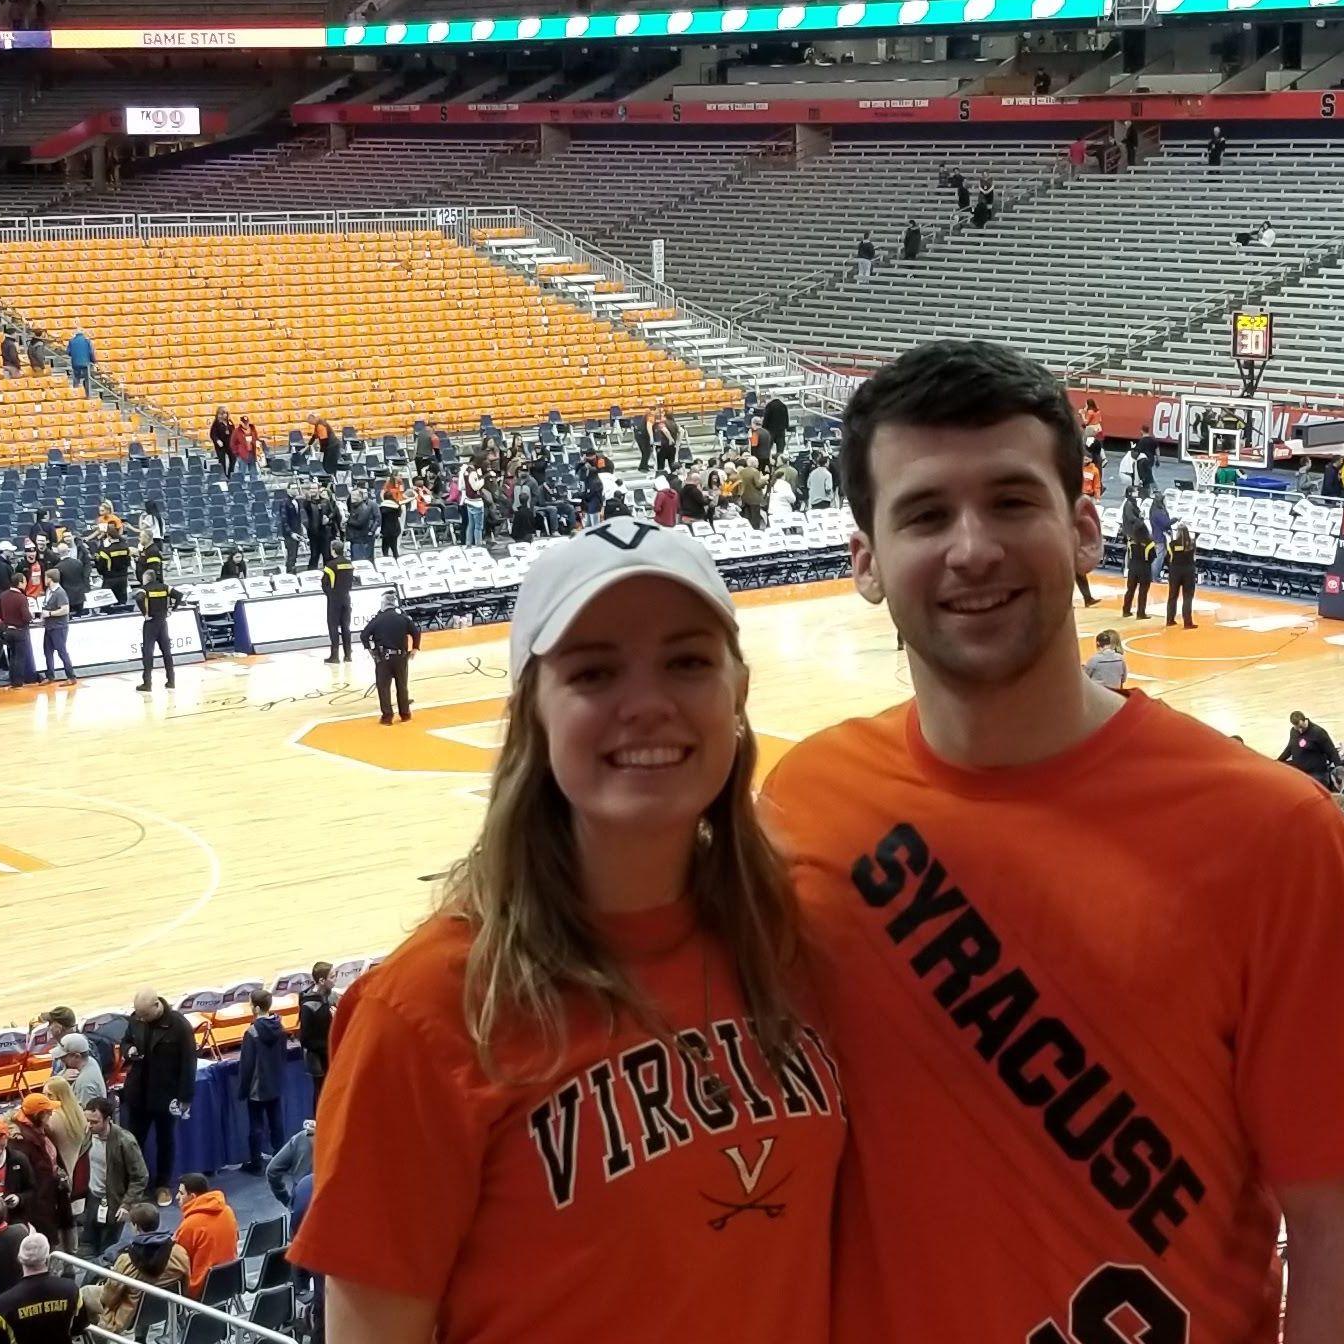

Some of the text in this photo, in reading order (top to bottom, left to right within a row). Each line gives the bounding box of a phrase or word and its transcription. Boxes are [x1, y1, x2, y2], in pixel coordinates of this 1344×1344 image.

[143, 32, 236, 46] GAME STATS
[672, 104, 681, 122] S
[959, 99, 970, 121] S
[1320, 90, 1336, 119] S
[438, 209, 457, 225] 125
[1239, 330, 1265, 354] 30
[584, 521, 660, 550] V
[851, 822, 1207, 1256] SYRACUSE
[719, 1136, 778, 1196] V
[43, 1299, 68, 1313] STAFF
